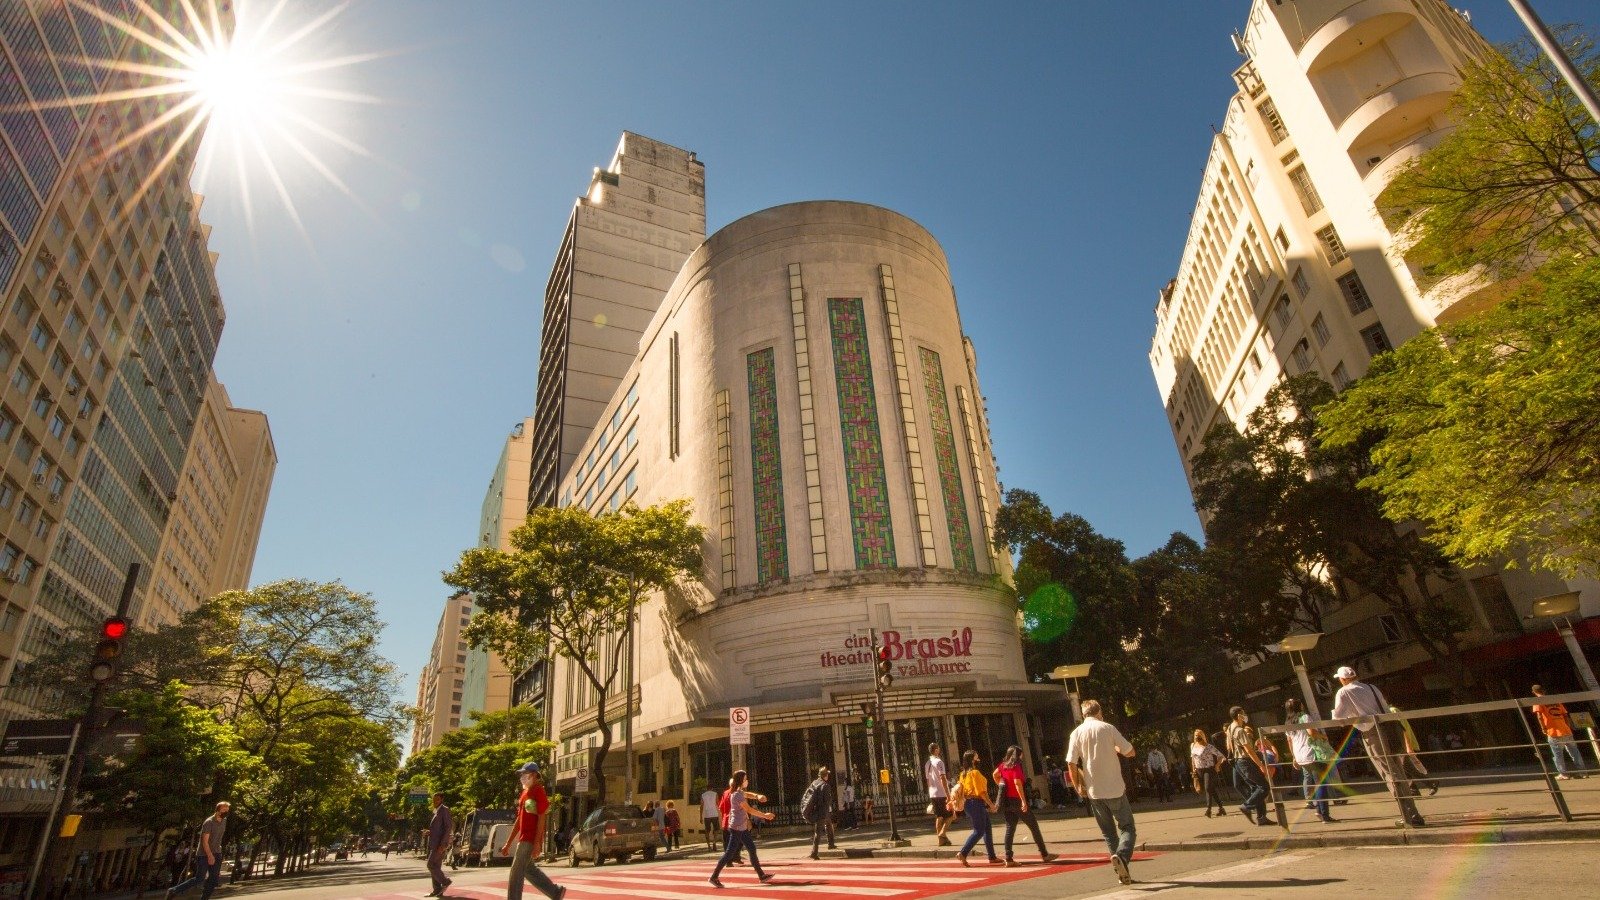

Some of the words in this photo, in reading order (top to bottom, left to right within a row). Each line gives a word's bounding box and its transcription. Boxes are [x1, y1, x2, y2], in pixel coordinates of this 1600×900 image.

[844, 633, 871, 649] cin
[882, 626, 972, 661] Brasil
[820, 649, 873, 668] theatr
[897, 658, 972, 676] vallourec
